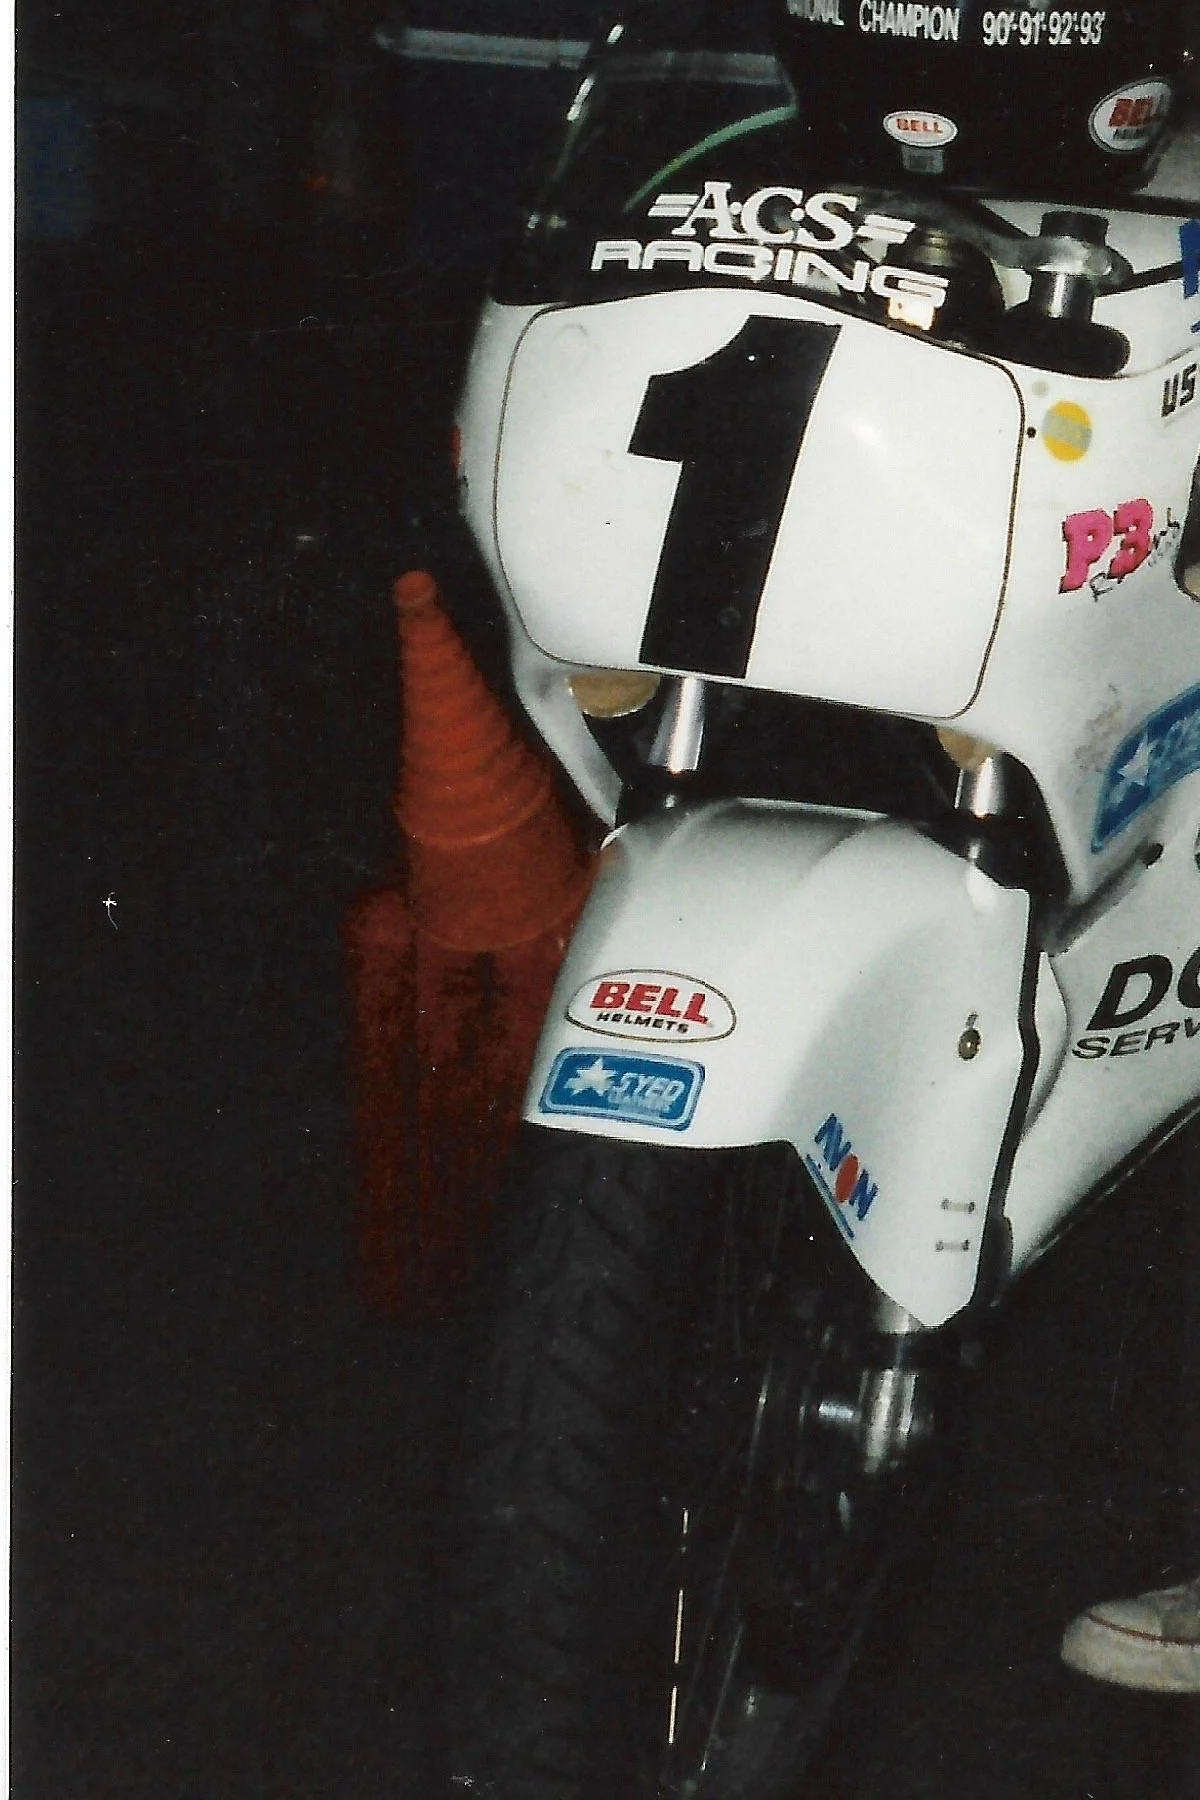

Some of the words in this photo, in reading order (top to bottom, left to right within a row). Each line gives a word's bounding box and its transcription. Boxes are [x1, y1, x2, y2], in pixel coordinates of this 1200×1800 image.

[896, 118, 943, 135] BELL
[590, 240, 951, 309] RACING
[628, 315, 842, 679] 1
[1059, 498, 1155, 594] P3
[590, 981, 708, 1025] BELL
[597, 1013, 690, 1034] HELMETS
[815, 1113, 879, 1221] AVON
